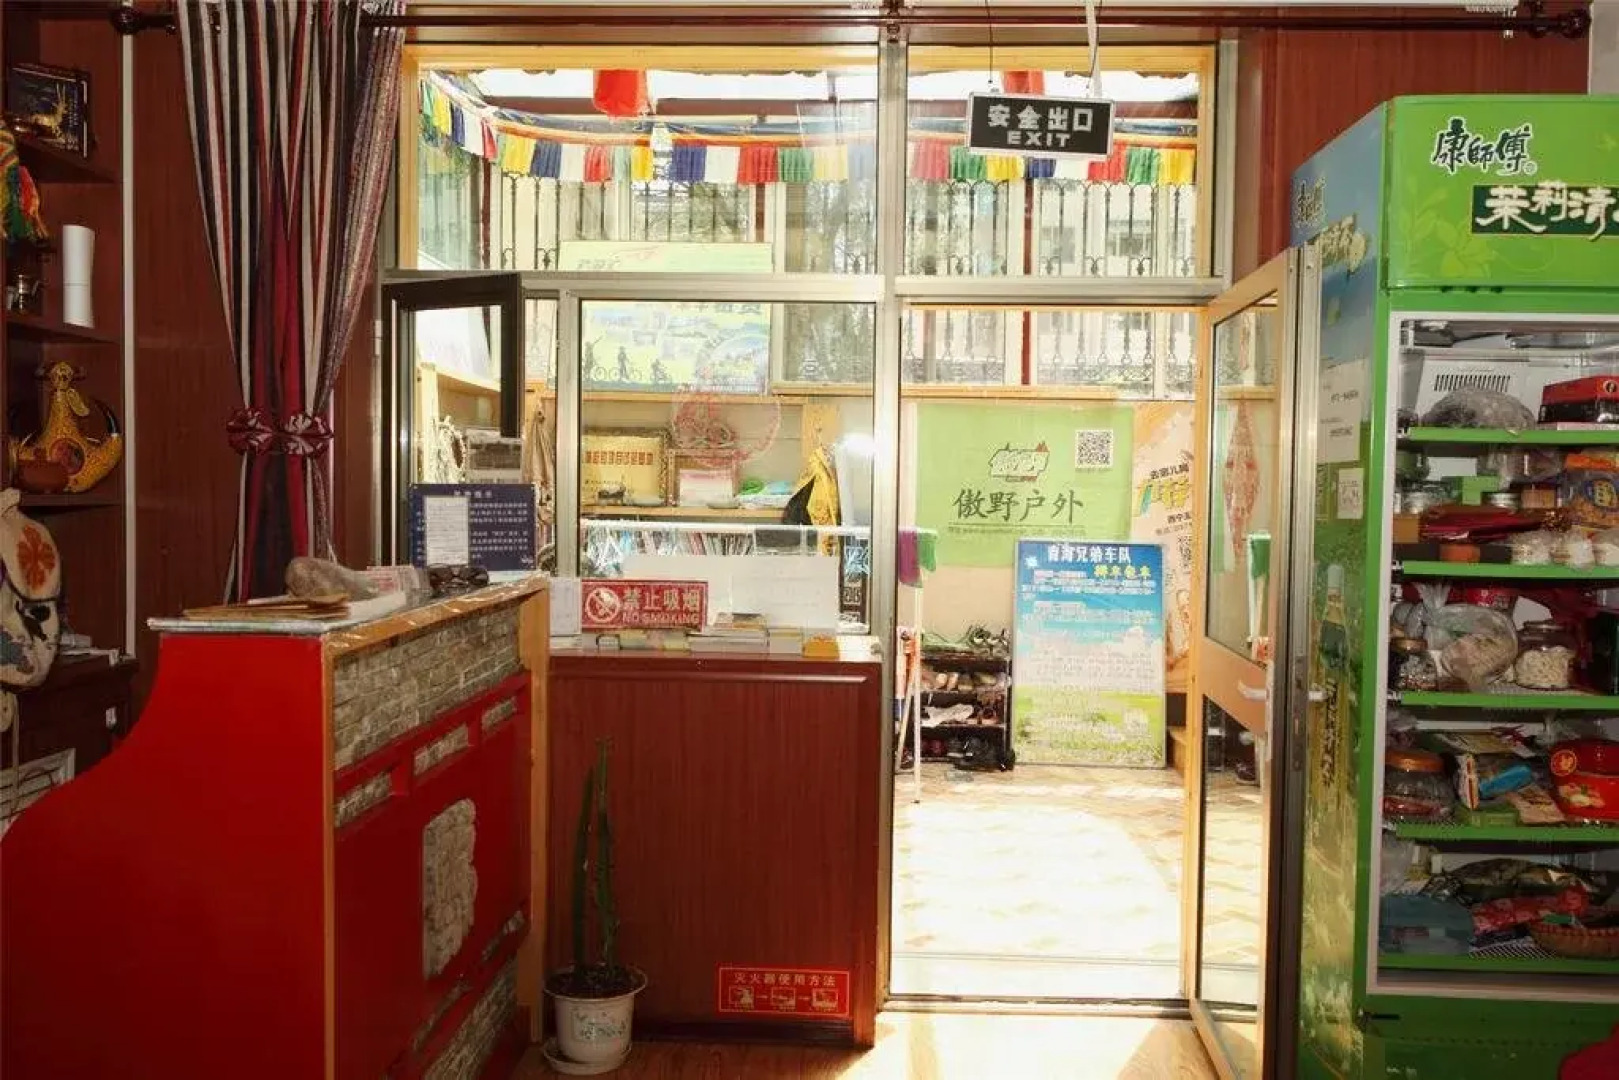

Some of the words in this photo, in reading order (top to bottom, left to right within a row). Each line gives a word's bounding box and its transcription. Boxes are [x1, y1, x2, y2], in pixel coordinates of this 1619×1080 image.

[987, 103, 1094, 132] 安全出口
[1006, 130, 1071, 148] EXIT
[1475, 180, 1619, 242] 茉莉清
[952, 487, 1084, 525] 傲野户外
[623, 587, 700, 612] 禁止吸烟
[622, 612, 640, 623] NO
[642, 613, 700, 625] SMOKING
